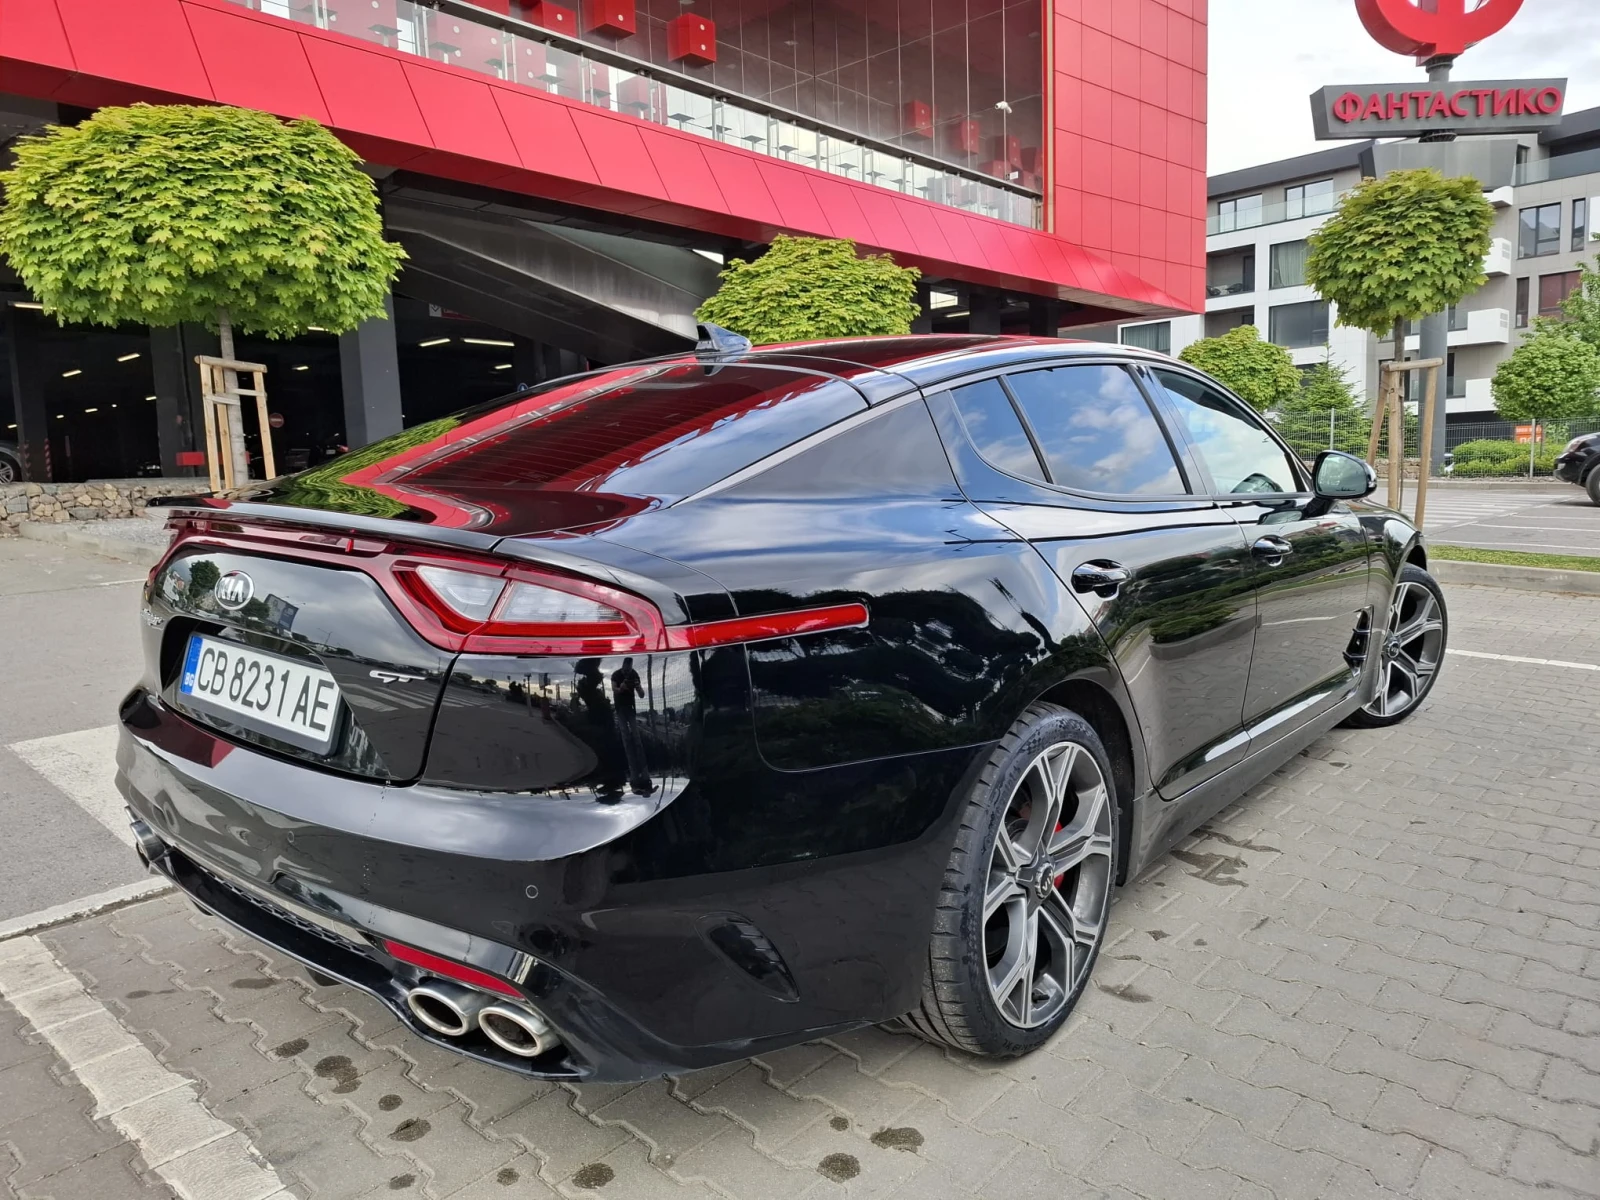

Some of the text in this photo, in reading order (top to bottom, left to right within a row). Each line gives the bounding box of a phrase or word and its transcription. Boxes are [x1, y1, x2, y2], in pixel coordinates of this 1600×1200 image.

[1333, 86, 1563, 123] ФАНТАСТИКО
[217, 577, 244, 603] KIA
[184, 671, 195, 687] BG
[198, 647, 335, 732] CB 8231 AE
